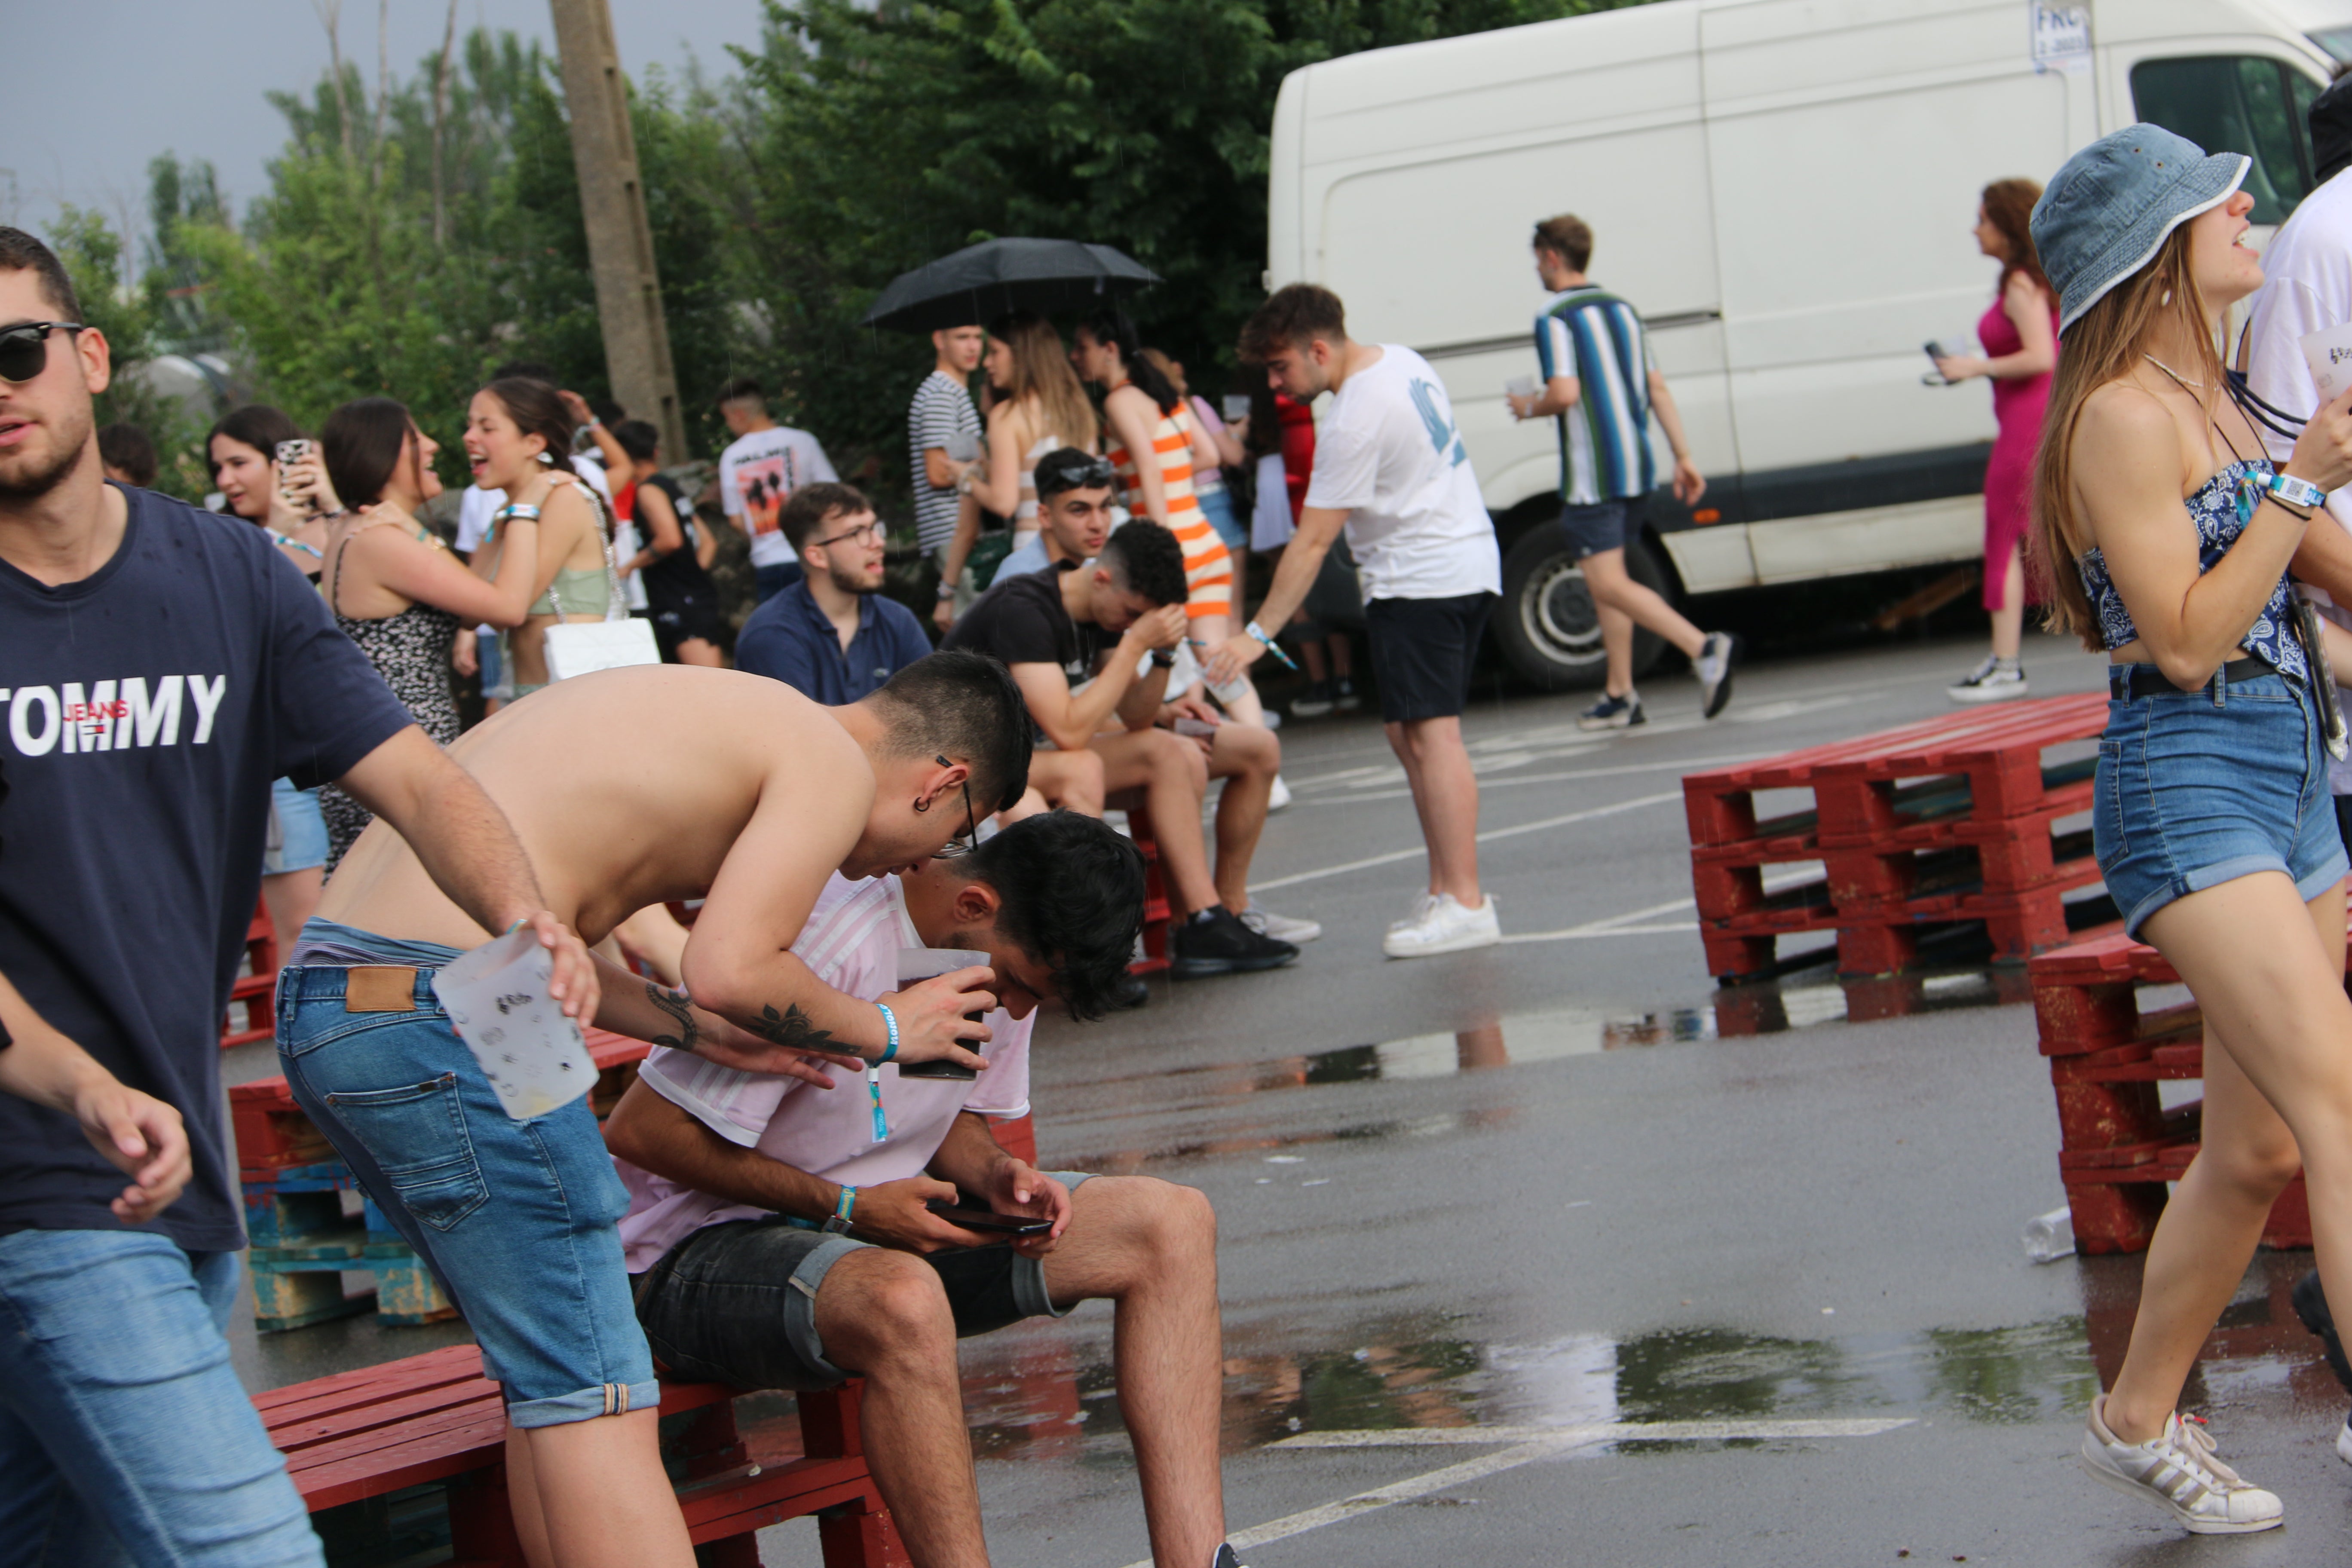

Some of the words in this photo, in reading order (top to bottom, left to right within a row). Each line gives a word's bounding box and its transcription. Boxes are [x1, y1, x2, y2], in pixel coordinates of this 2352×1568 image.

[0, 674, 226, 756] OMMY
[63, 699, 129, 722] JEANS
[876, 1004, 899, 1045] MONOLO
